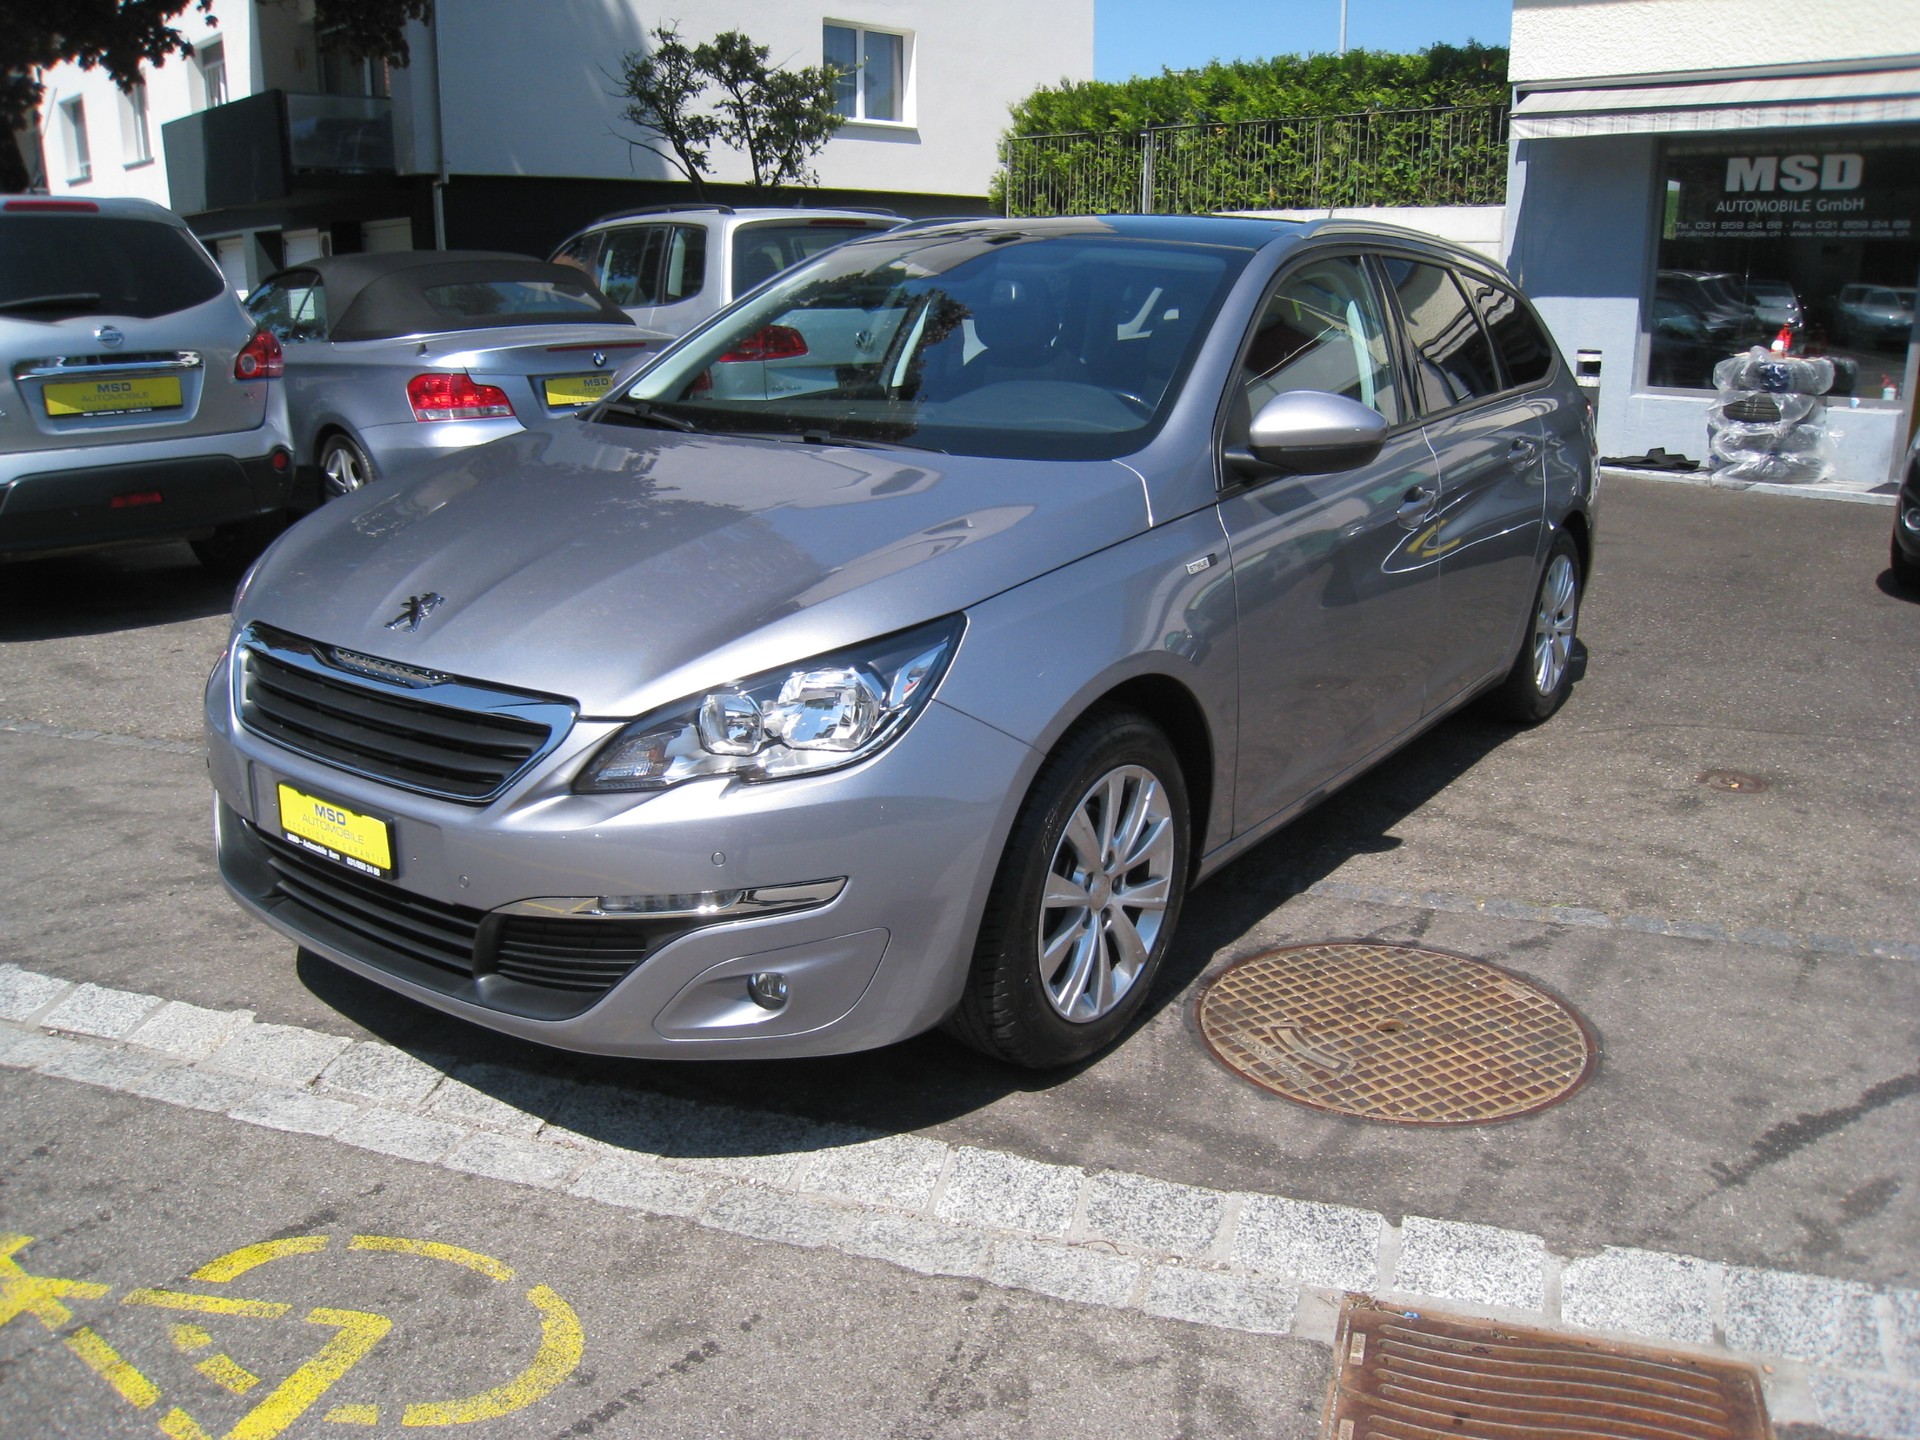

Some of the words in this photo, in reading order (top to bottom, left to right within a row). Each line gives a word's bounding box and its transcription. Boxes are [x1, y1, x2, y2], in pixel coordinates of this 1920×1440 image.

[1725, 153, 1864, 192] MSD
[1715, 199, 1811, 213] AUTOMOBILE
[1816, 198, 1865, 212] GmbH
[1695, 221, 1716, 229] 031
[1747, 221, 1763, 229] 24
[1792, 221, 1812, 229] Fax
[97, 382, 132, 393] MSD
[584, 377, 609, 387] MSD
[81, 391, 150, 402] AUTOMOBILE
[314, 803, 346, 826] MSD
[302, 813, 364, 844] AUTOMOBILE
